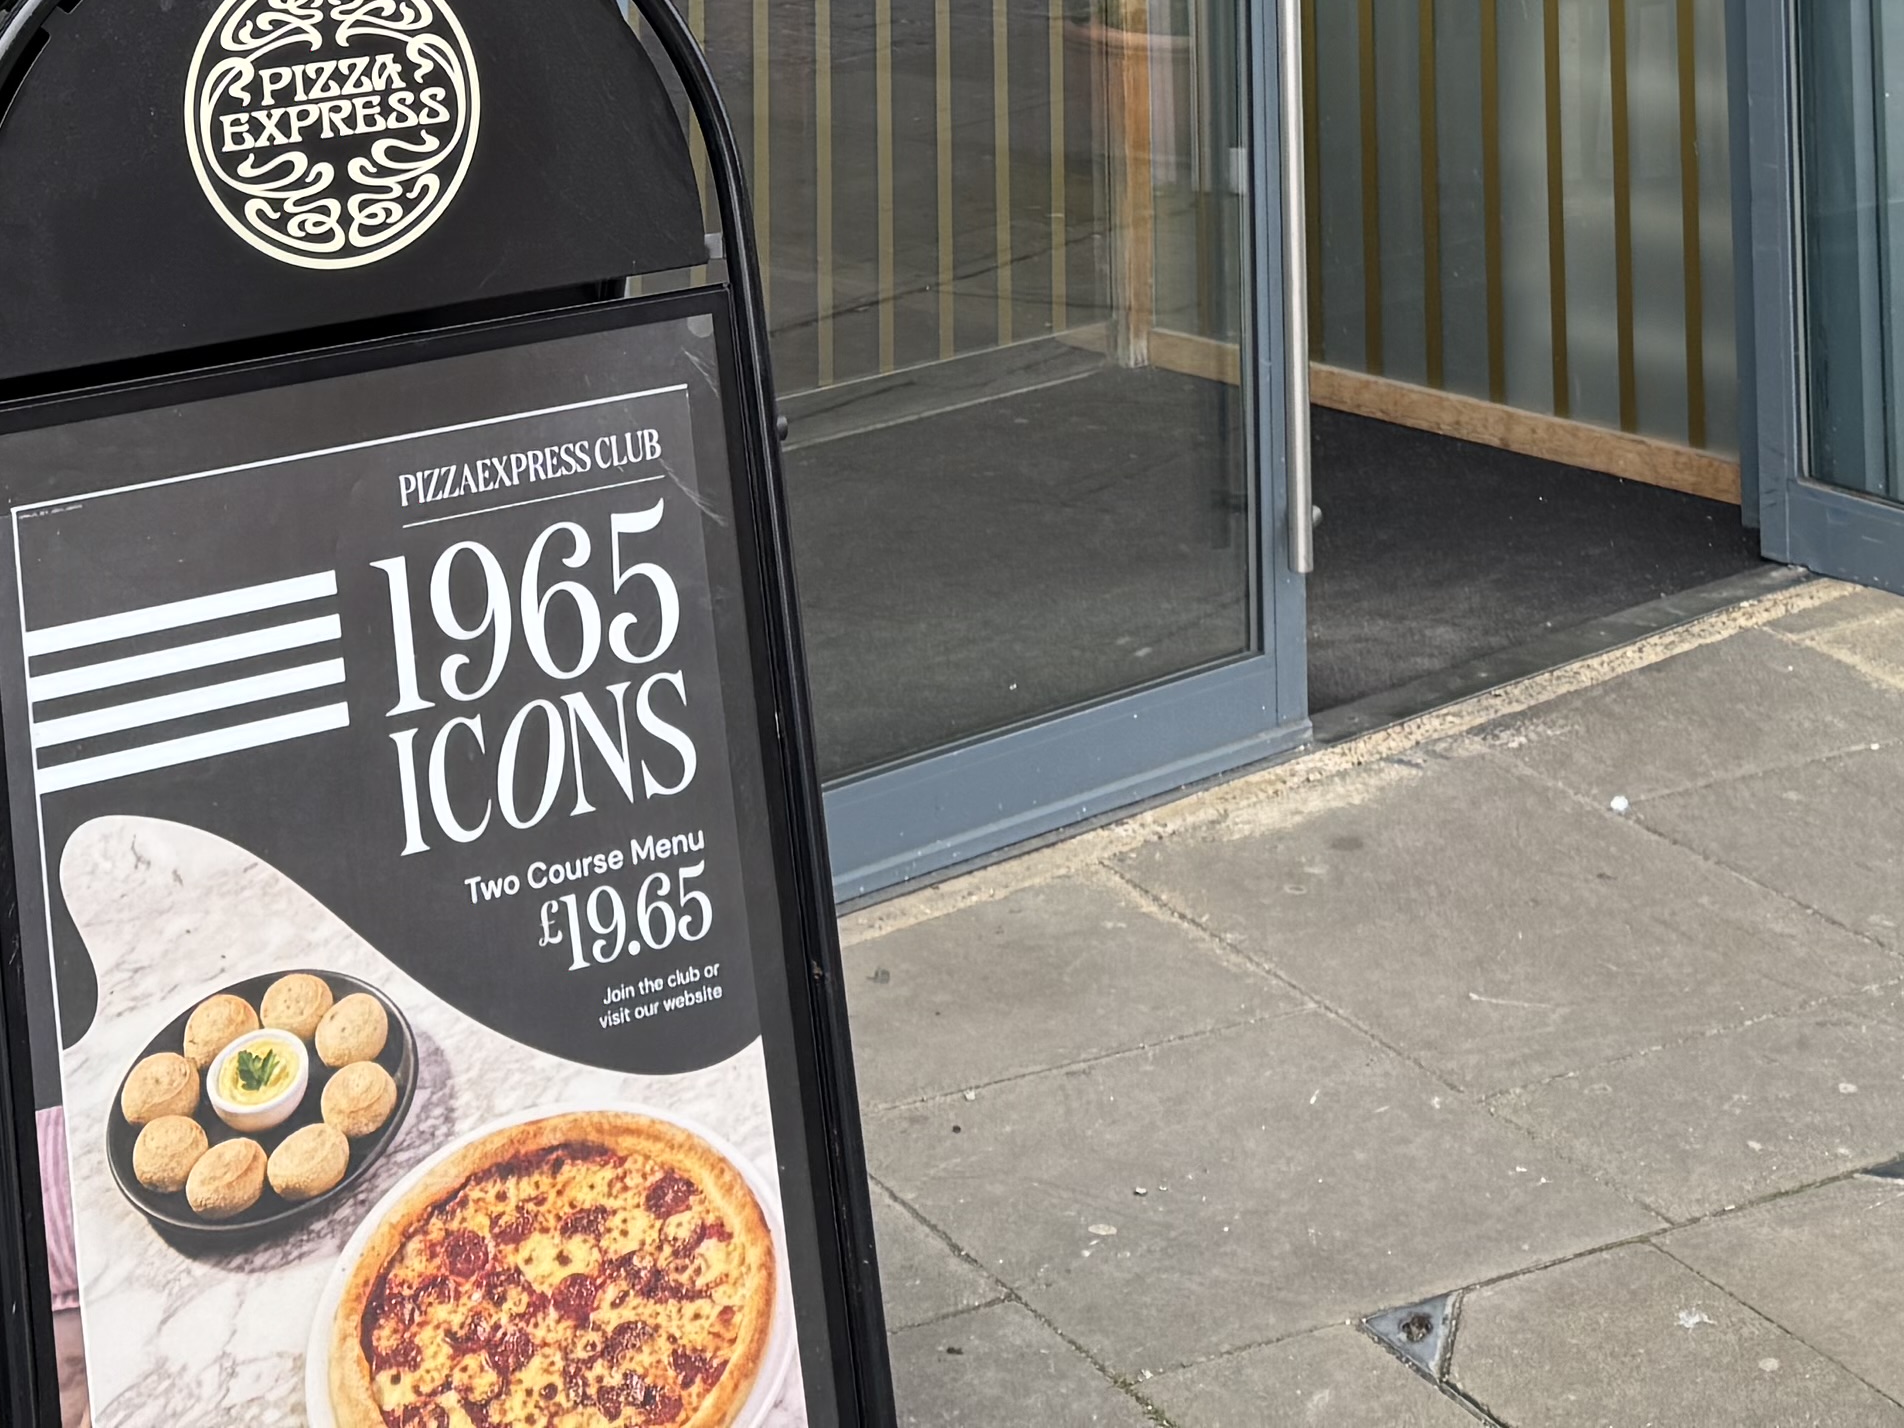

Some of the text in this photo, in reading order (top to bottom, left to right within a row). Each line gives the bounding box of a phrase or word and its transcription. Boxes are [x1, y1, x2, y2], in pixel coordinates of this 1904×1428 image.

[258, 52, 406, 106] PIZZA
[219, 87, 451, 152] EXPRESS
[398, 428, 663, 507] PIZZAEXPRESS CLUB
[369, 497, 680, 717] 1965
[388, 669, 697, 857] ICONS
[464, 829, 705, 904] Two Course Menu
[538, 859, 713, 972] £19.65
[599, 985, 723, 1029] visit our website
[603, 963, 720, 1005] Join the club or
